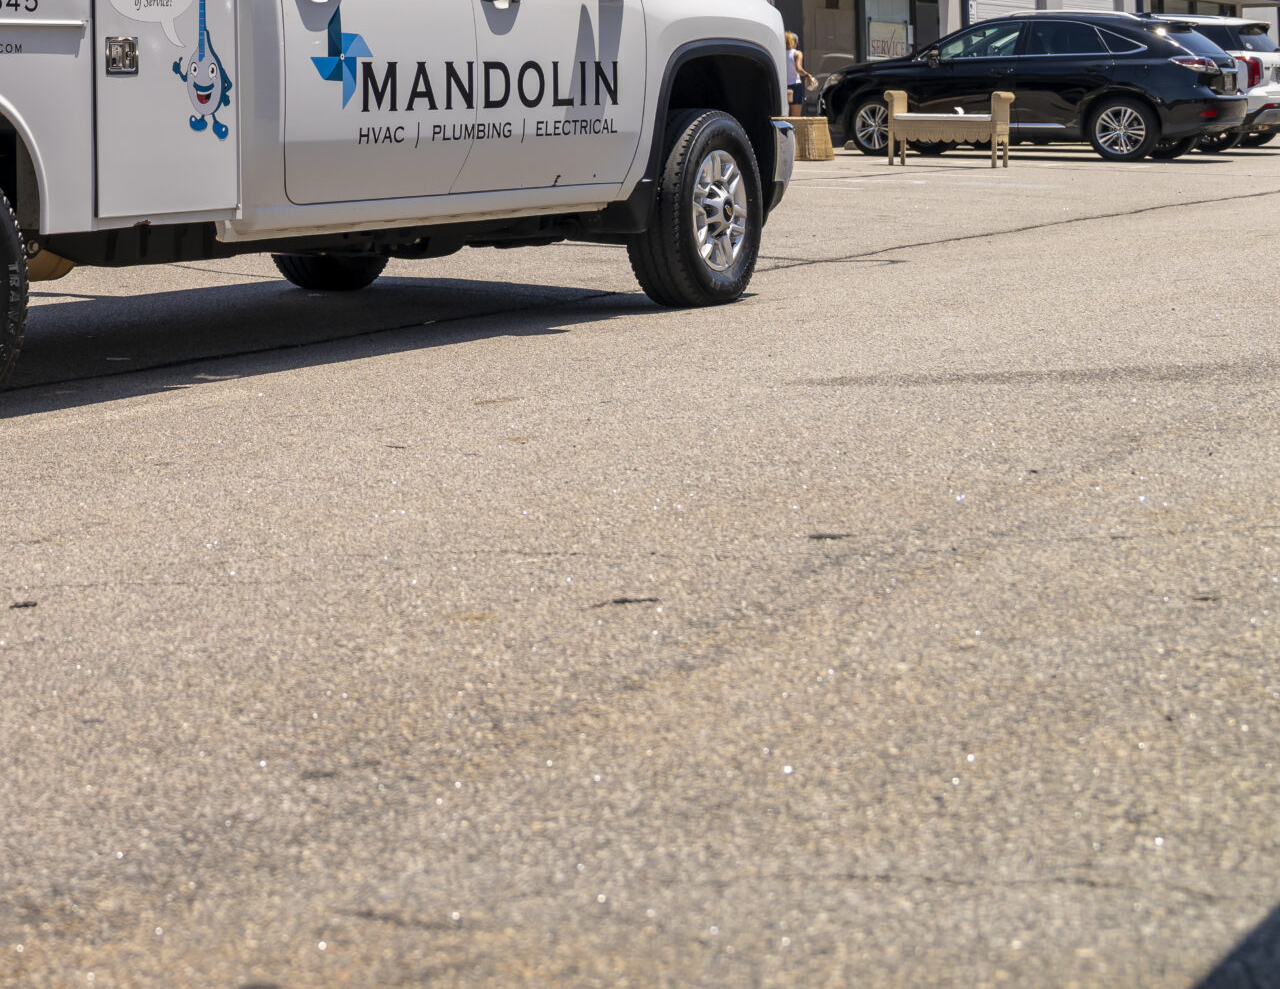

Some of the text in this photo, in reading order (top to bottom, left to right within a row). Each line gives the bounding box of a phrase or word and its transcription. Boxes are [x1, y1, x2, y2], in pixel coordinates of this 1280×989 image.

[871, 29, 906, 57] SERVICE
[361, 60, 619, 113] MANDOLIN
[358, 126, 405, 145] HVAC
[431, 122, 513, 142] PLUMBING
[535, 118, 618, 137] ELECTRICAL
